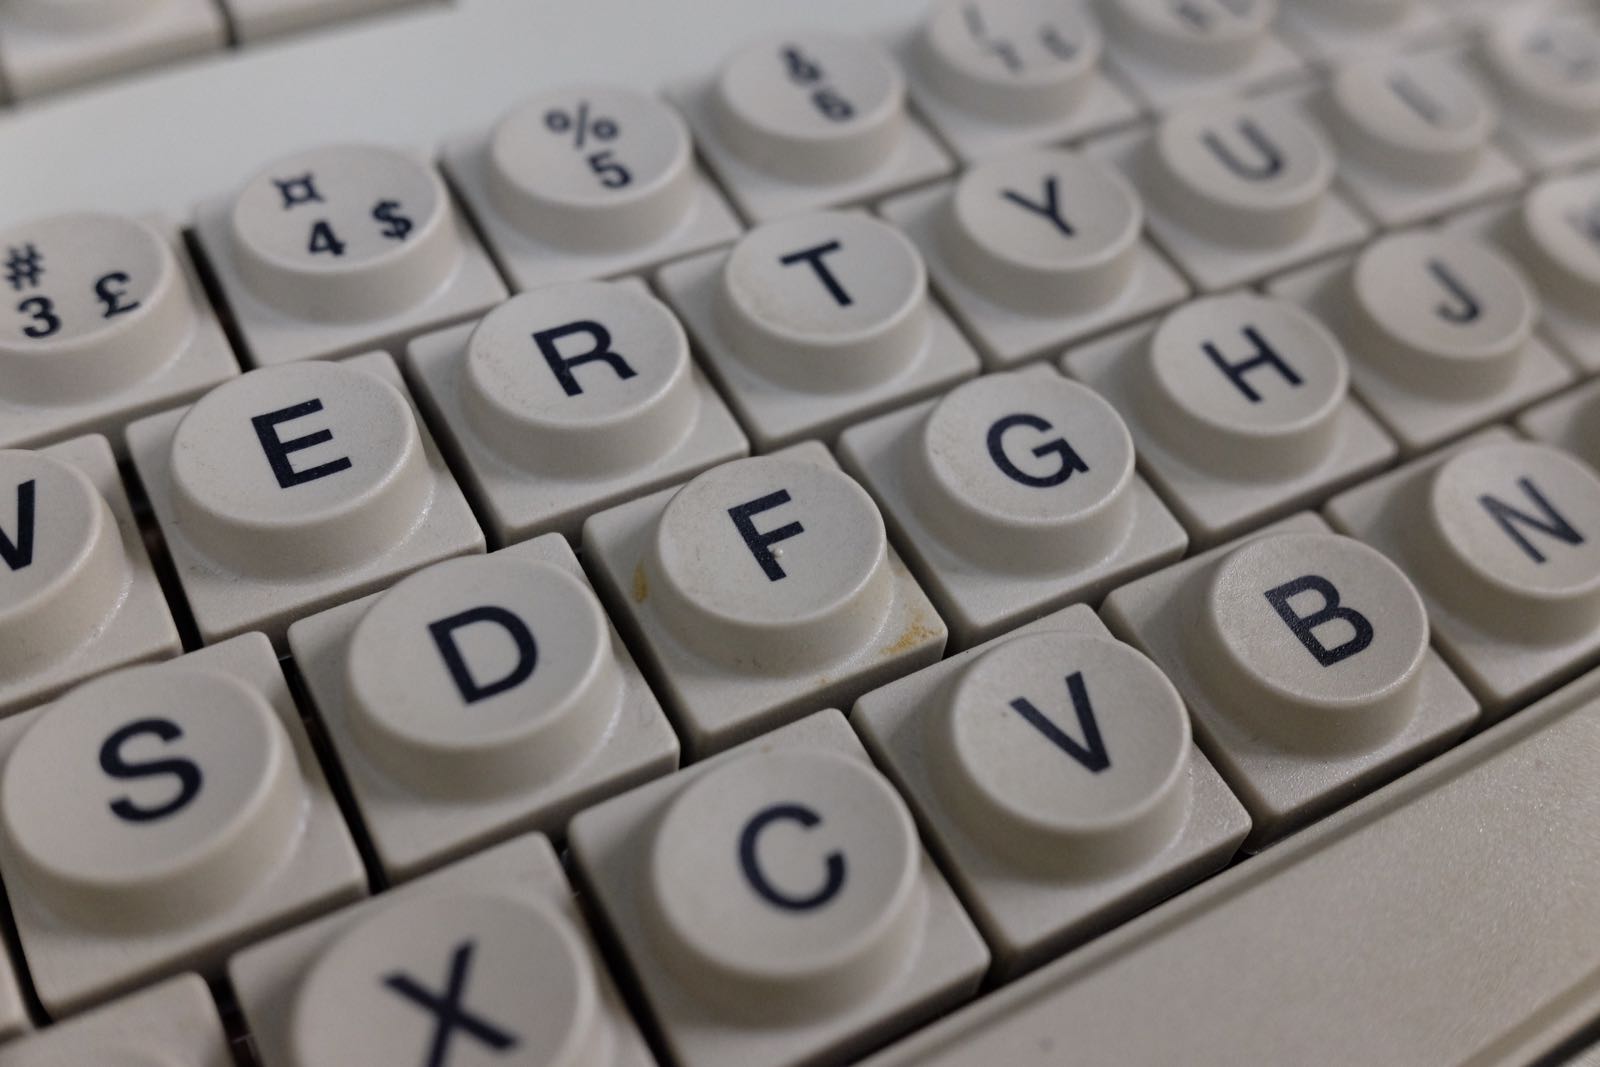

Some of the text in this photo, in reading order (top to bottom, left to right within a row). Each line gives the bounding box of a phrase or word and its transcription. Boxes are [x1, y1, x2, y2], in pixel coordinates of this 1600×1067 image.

[542, 101, 620, 149] %
[812, 89, 855, 122] 6
[587, 151, 633, 190] 5
[1200, 117, 1284, 181] U
[307, 198, 415, 257] 4 $
[1001, 175, 1076, 238] Y
[5, 242, 44, 291] #
[780, 240, 853, 307] T
[1427, 259, 1482, 325] J
[17, 271, 140, 339] 3 £
[531, 320, 638, 397] R
[1202, 326, 1305, 404] H
[250, 397, 353, 489] E
[986, 413, 1090, 489] G
[727, 488, 805, 582] F
[1479, 475, 1586, 564] N
[427, 605, 539, 705] D
[1263, 574, 1375, 668] B
[1009, 670, 1112, 775] V
[98, 717, 204, 825] S
[738, 803, 847, 914] C
[380, 939, 520, 1067] X
